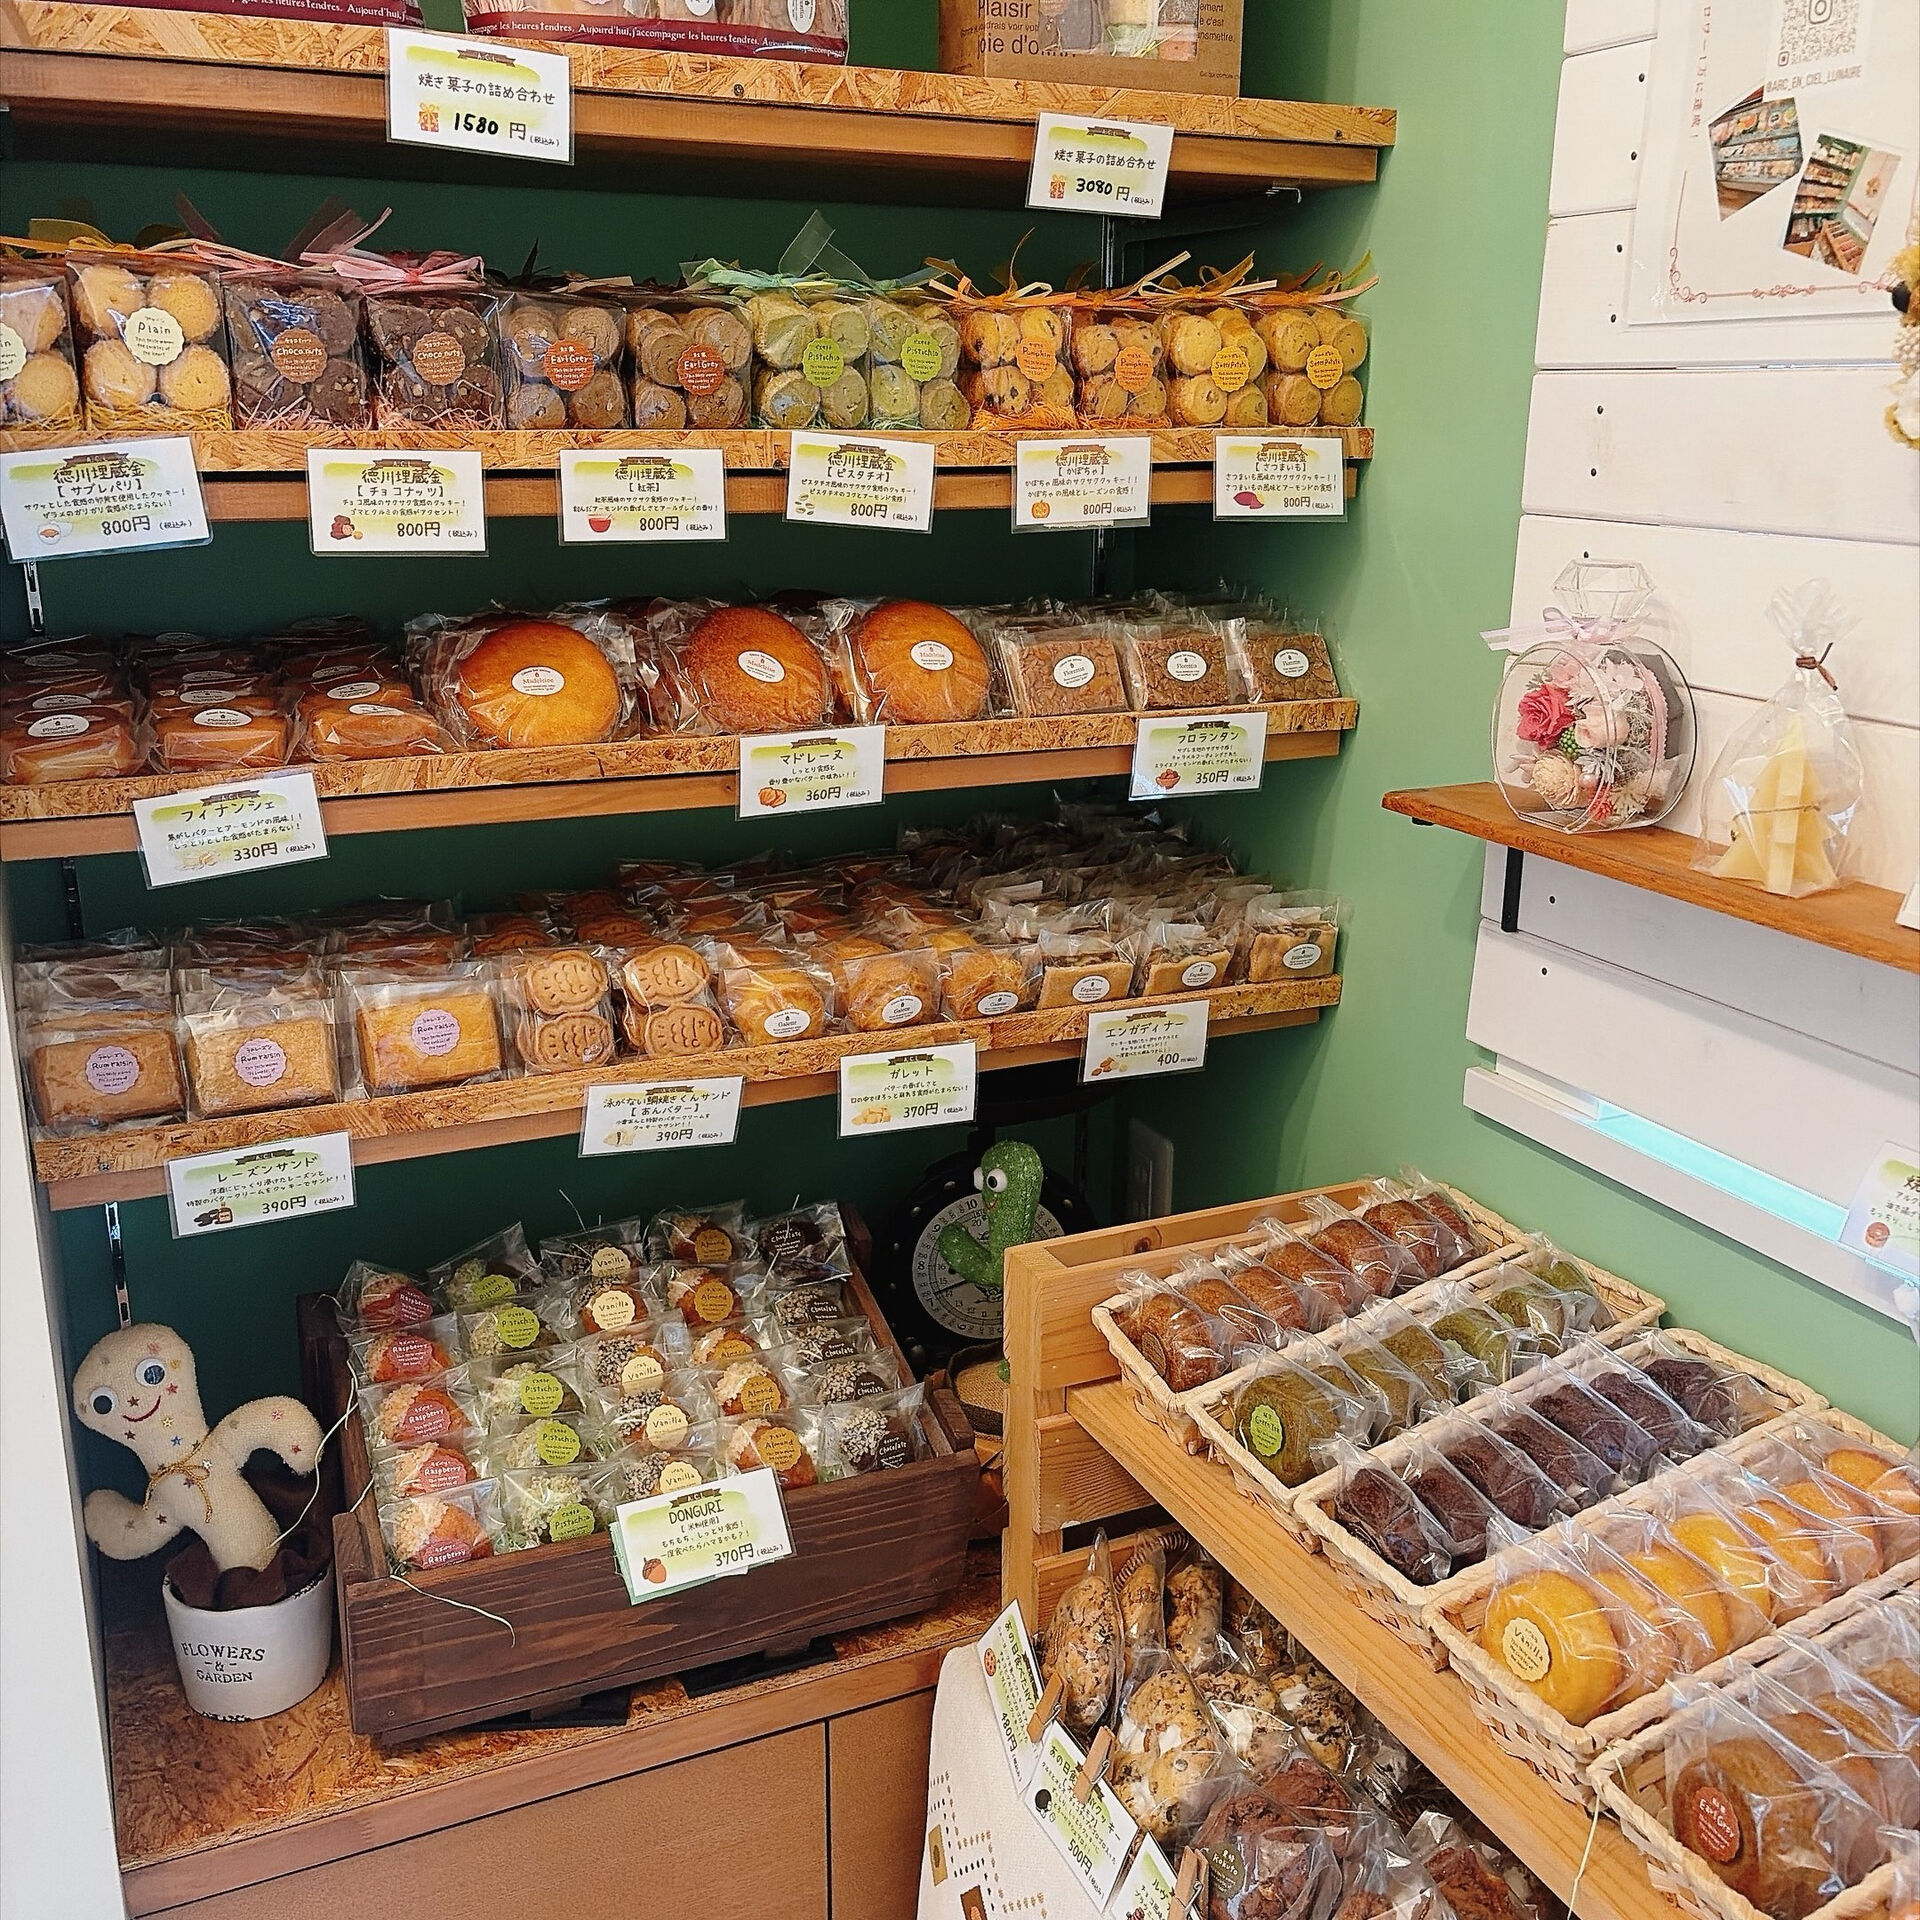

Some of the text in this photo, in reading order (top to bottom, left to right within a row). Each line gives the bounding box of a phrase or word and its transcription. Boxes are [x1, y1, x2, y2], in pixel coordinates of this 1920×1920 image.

[500, 21, 511, 30] les
[512, 22, 539, 31] heures
[540, 22, 575, 33] tendres.
[688, 29, 698, 40] les
[700, 31, 728, 42] heures
[418, 72, 556, 105] 焼き菓子の詰め合わせ
[454, 112, 499, 135] 1580
[509, 122, 527, 140] 円
[1054, 149, 1156, 170] 焼き菓子の詰め合わせ
[1076, 178, 1112, 196] 3080
[1116, 186, 1130, 201] 円
[138, 322, 170, 335] Plain
[1022, 347, 1051, 359] Pumpkin
[1120, 358, 1149, 369] Pumpkin
[828, 452, 897, 472] 徳川埋蔵金
[1055, 455, 1110, 467] 徳川埋蔵金
[1256, 451, 1307, 463] 徳川埋蔵金
[53, 461, 145, 485] 徳川埋蔵金
[615, 467, 678, 481] 徳川埋蔵金
[1058, 466, 1105, 476] 【かぼちゃ】
[1255, 462, 1306, 472] 【さつまいも】
[361, 469, 444, 485] 徳川埋蔵金
[827, 467, 890, 483] 【ピスタチオ】
[357, 485, 444, 497] 【チョコナッツ】
[629, 483, 660, 493] 【紅茶】
[1083, 502, 1112, 516] 800円
[1283, 496, 1311, 508] 800円
[850, 502, 888, 519] 800円
[101, 514, 151, 536] 800円
[396, 521, 441, 537] 800円
[640, 516, 680, 531] 800円
[1178, 732, 1239, 744] フロランタン
[780, 749, 844, 765] マドレーヌ
[792, 764, 836, 775] しっとり食感と
[1195, 769, 1229, 784] 350円
[805, 786, 841, 802] 360円
[181, 800, 275, 823] フィナンシェ
[174, 823, 301, 850] しっとりとした食感がたまらない！
[233, 842, 278, 862] 330円
[417, 1022, 455, 1034] Rum raisin
[1105, 1021, 1184, 1038] エンガディナー
[92, 1060, 133, 1070] Rum raisin
[241, 1052, 281, 1064] Rum raisin
[1157, 1052, 1180, 1067] 400
[890, 1066, 933, 1079] ガレット
[884, 1081, 937, 1092] バターの香ばしさと
[631, 1103, 699, 1117] 【あんバター】
[903, 1102, 939, 1118] 370円
[656, 1128, 693, 1142] 390円
[218, 1155, 318, 1183] レーズンサンド
[262, 1195, 307, 1215] 390円
[966, 1198, 978, 1210] 10
[597, 1257, 624, 1269] Vanilla
[599, 1301, 629, 1312] Vanilla
[825, 1347, 855, 1359] Chocolate
[627, 1368, 657, 1380] Vanilla
[408, 1409, 444, 1424] Raspberry
[652, 1418, 682, 1429] Vanilla
[765, 1440, 794, 1449] Almond
[879, 1441, 907, 1455] Chocolate
[424, 1465, 461, 1477] Raspberry
[665, 1474, 695, 1486] Vanilla
[669, 1500, 725, 1525] DONGURI
[680, 1517, 720, 1533] 【米粉使用】
[661, 1521, 744, 1548] もちもち、しっとり食感！
[660, 1530, 750, 1557] 一度食べたらハマるかも？！
[427, 1549, 466, 1564] Raspberry
[714, 1543, 784, 1567] 370円 (税込み)
[1514, 1626, 1544, 1661] Vanilla
[181, 1642, 266, 1662] FLOWERS
[214, 1661, 225, 1672] &
[196, 1669, 253, 1683] GARDEN
[1001, 1711, 1018, 1752] 480円
[1067, 1840, 1093, 1876] 500円
[1212, 1852, 1238, 1876] Kokuto
